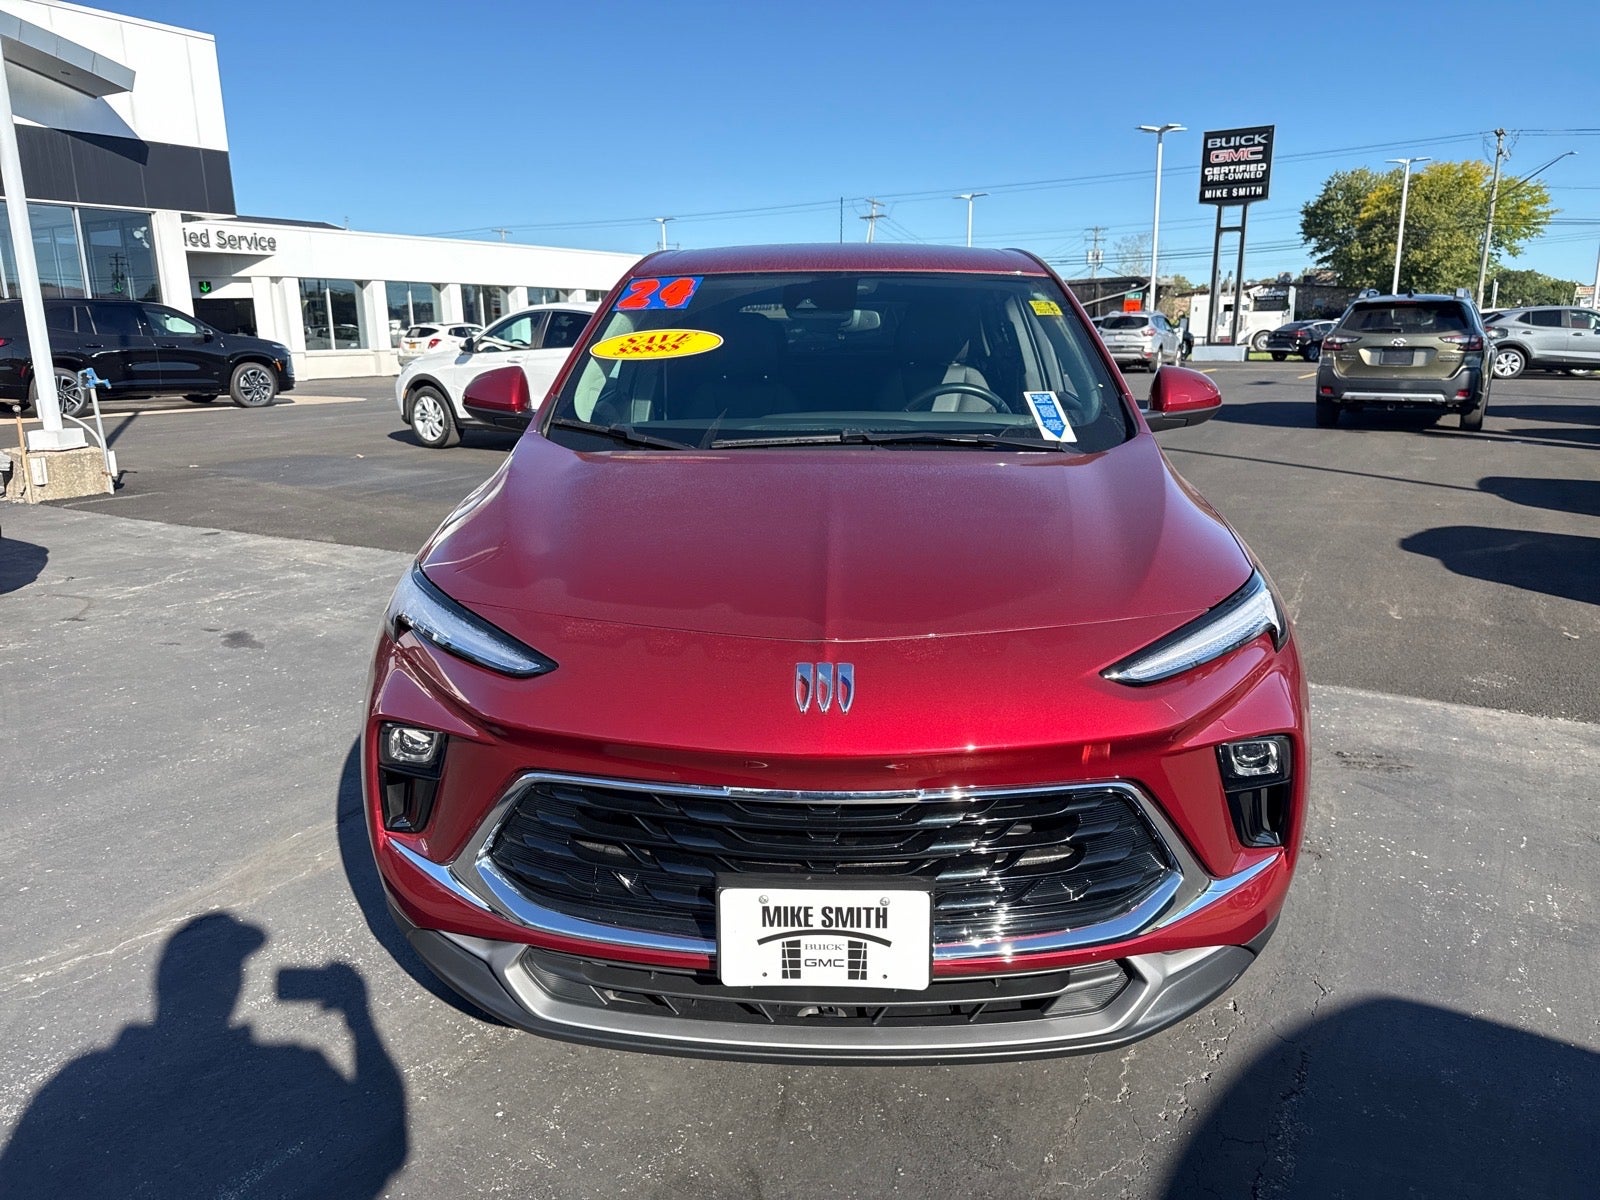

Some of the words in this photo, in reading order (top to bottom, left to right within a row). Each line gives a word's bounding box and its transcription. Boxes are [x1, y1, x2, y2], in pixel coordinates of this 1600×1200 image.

[1207, 133, 1269, 149] BUICK
[1210, 146, 1264, 164] GMC
[1204, 163, 1267, 176] CERTIFIED
[1207, 171, 1263, 182] PRE-OWNED
[1204, 188, 1228, 199] MIKE
[1232, 186, 1263, 197] SMITH
[216, 230, 277, 252] Service
[617, 277, 696, 309] 24
[761, 905, 814, 928] MIKE
[821, 905, 888, 929] SMITH
[804, 943, 845, 951] BUICK
[804, 958, 845, 967] GMC
